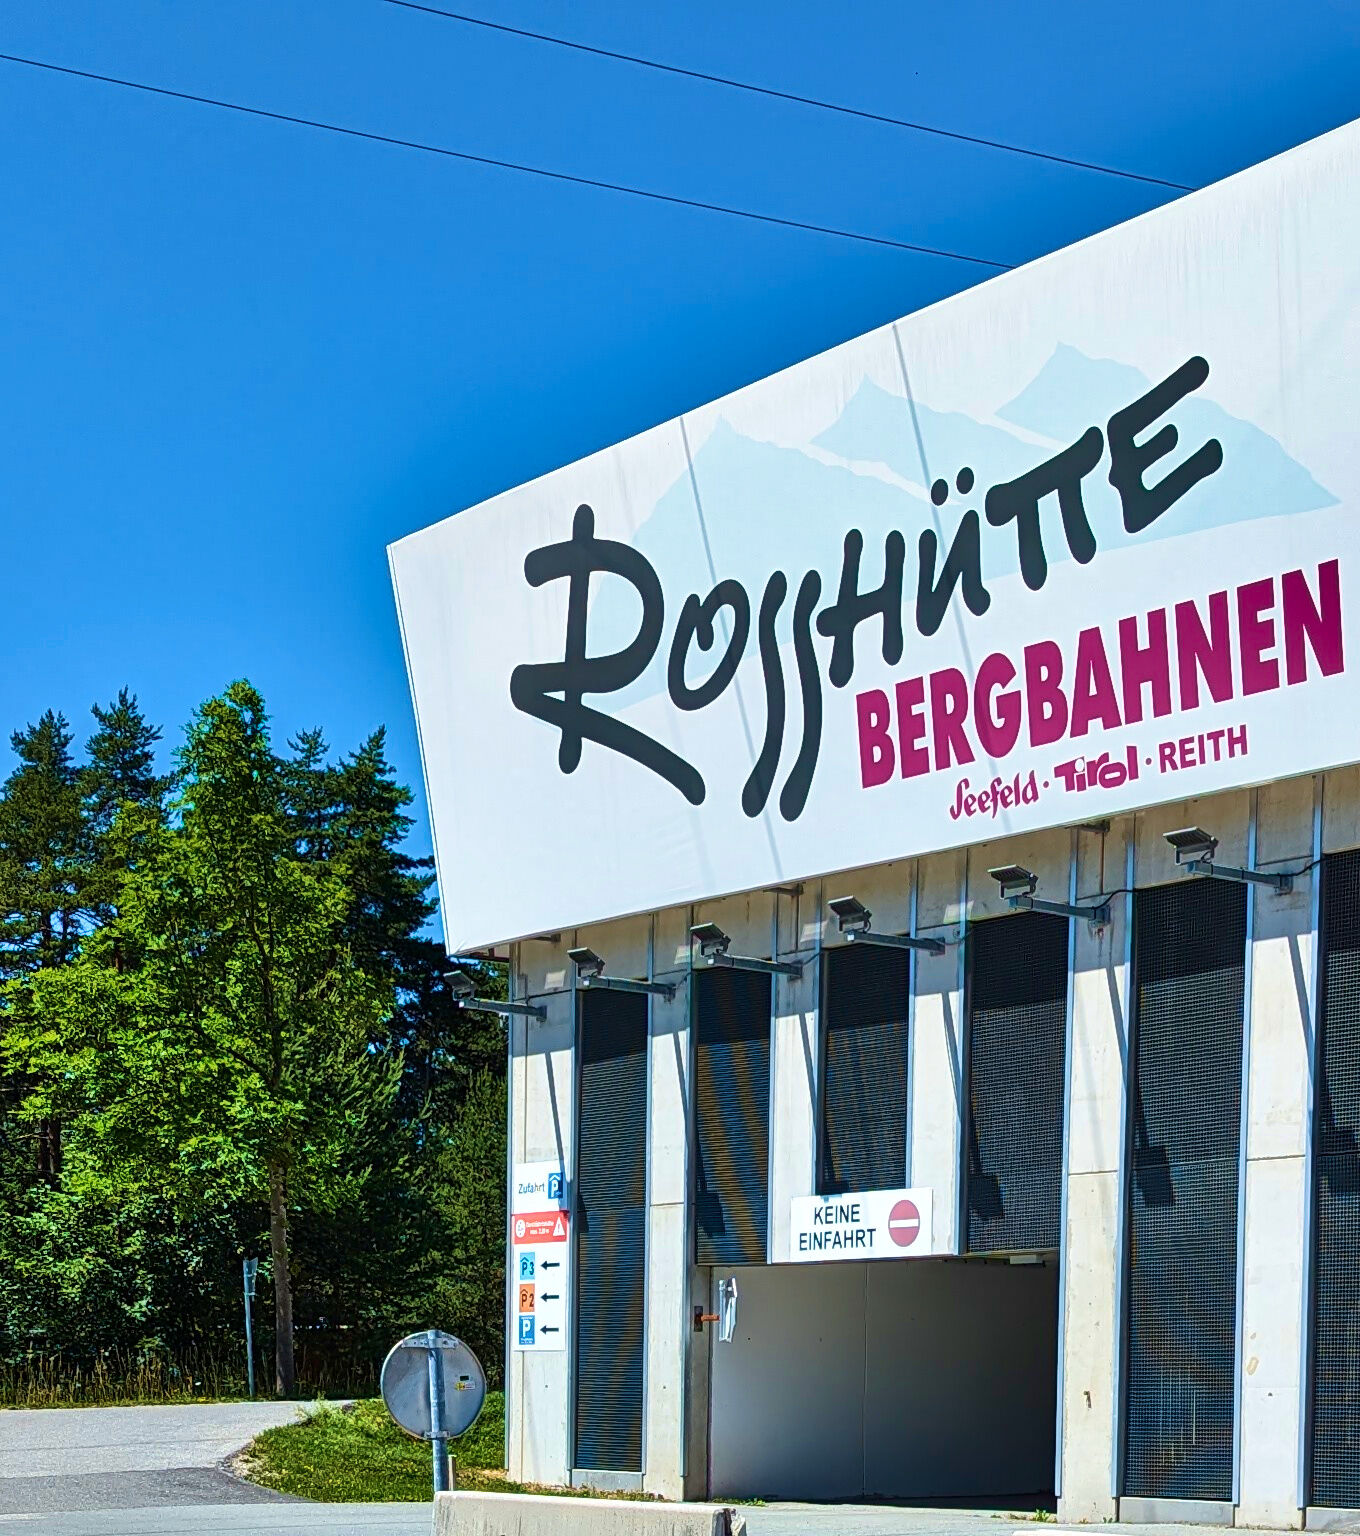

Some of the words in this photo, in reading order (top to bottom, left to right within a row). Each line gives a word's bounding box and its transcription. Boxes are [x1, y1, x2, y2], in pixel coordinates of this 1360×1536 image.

[855, 558, 1345, 790] BERGBAHNEN
[949, 769, 1039, 820] Seefeld
[1054, 745, 1140, 793] Tirol
[1158, 724, 1249, 774] REITH
[518, 1182, 545, 1194] Zufahrt
[814, 1204, 860, 1225] KEINE
[799, 1228, 876, 1251] EINFAHRT
[522, 1319, 531, 1338] P
